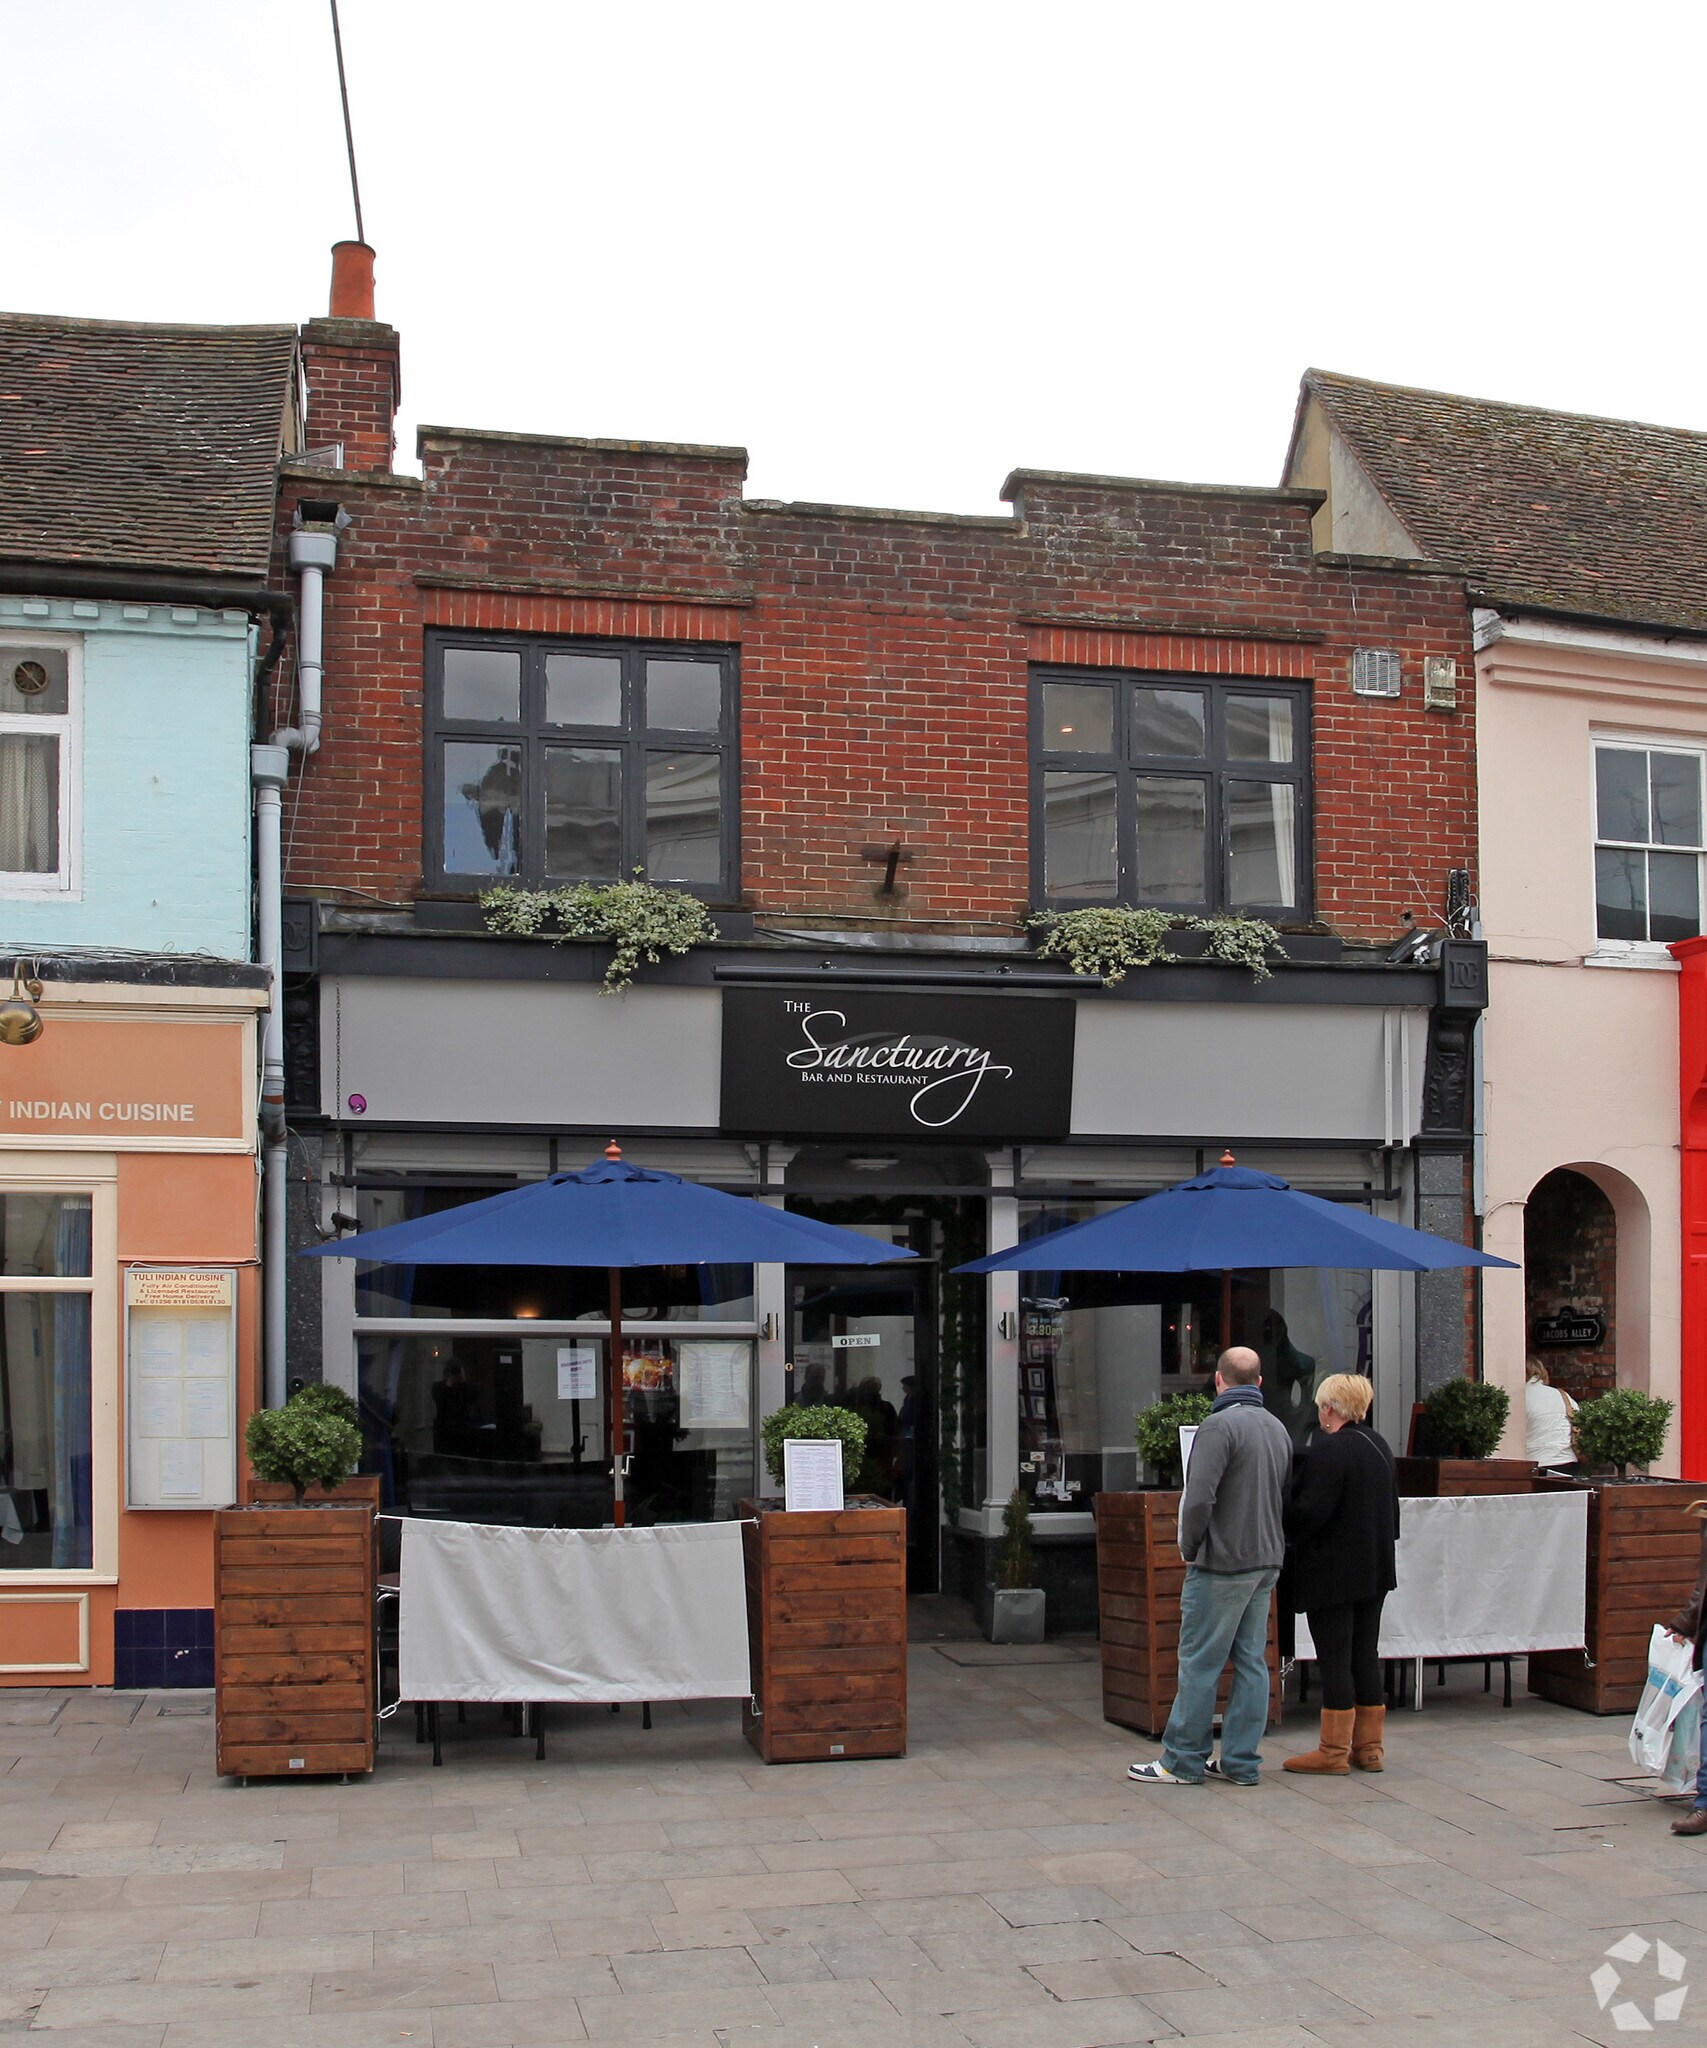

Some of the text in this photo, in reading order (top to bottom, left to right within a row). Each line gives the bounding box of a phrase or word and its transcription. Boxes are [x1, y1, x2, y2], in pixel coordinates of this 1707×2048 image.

[784, 1000, 811, 1013] THE
[786, 1010, 1013, 1127] Sanctuary
[801, 1071, 928, 1085] BAR AND RESTAURANT
[9, 1100, 194, 1122] INDIAN CUISINE
[133, 1273, 225, 1282] TULI INDIAN CUISINE
[1571, 1328, 1592, 1338] ALLEY
[840, 1337, 872, 1346] OPEN
